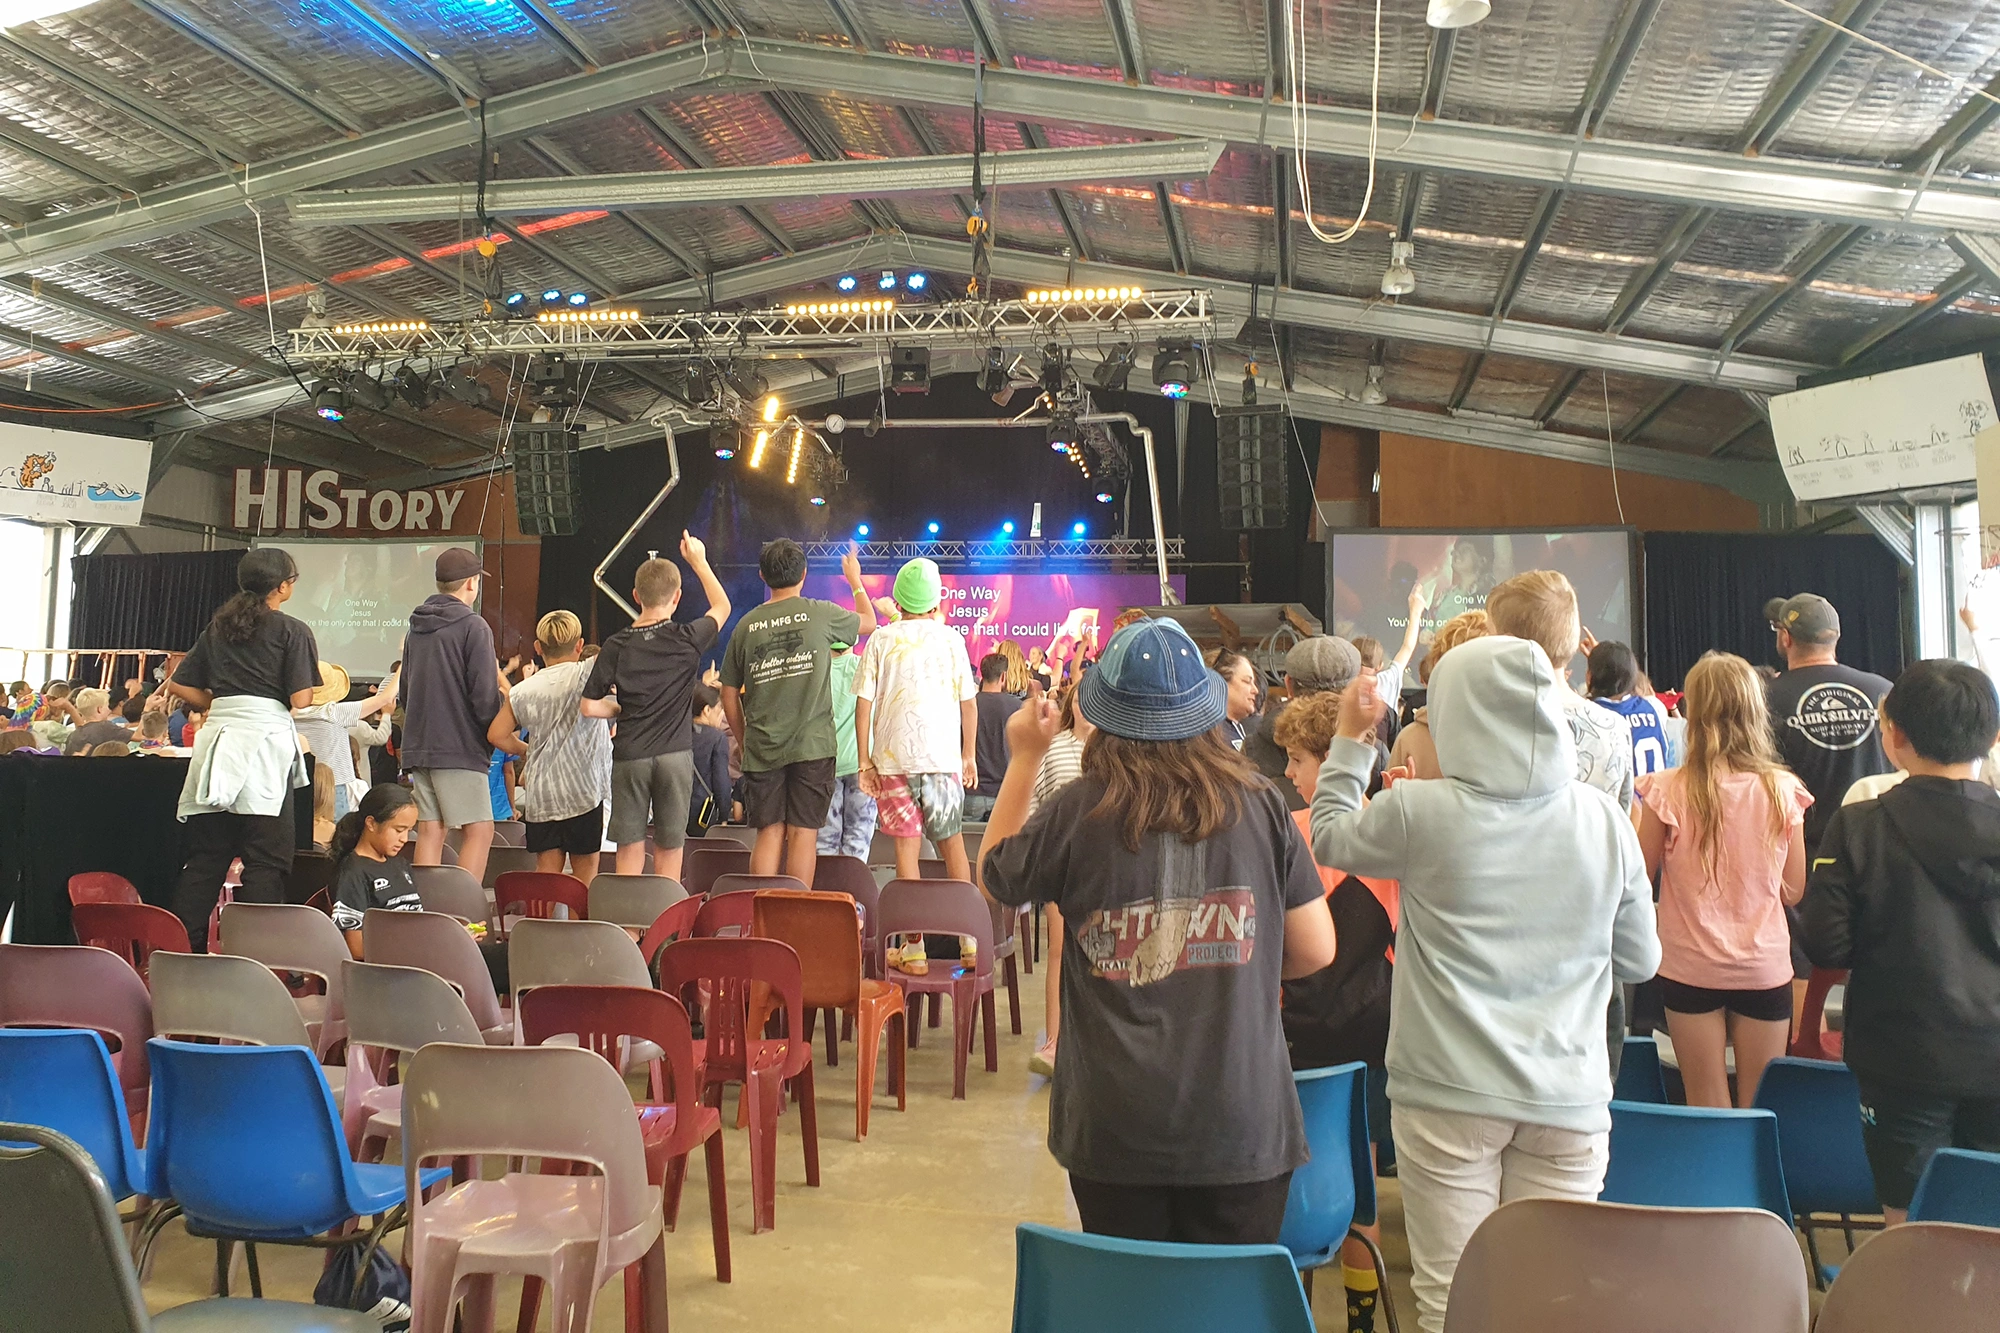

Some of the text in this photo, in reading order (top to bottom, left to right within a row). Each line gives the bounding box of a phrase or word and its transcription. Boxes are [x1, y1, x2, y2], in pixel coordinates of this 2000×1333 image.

[941, 586, 1001, 603] One Way
[1454, 595, 1475, 605] One
[345, 599, 378, 608] One Way
[350, 609, 372, 617] Jesus
[948, 604, 989, 618] Jesus
[318, 619, 330, 627] the
[330, 619, 346, 629] only
[362, 619, 377, 627] that
[382, 619, 402, 627] could
[749, 613, 811, 632] RPM MFG CO.
[1387, 617, 1410, 628] You'
[1419, 618, 1433, 628] the
[973, 622, 1000, 636] that
[1003, 622, 1008, 636] I
[1011, 622, 1049, 636] could
[1806, 689, 1862, 711] THE ORIGINAL
[1810, 723, 1866, 733] SURF COMPANY
[1188, 943, 1240, 961] PROJECT
